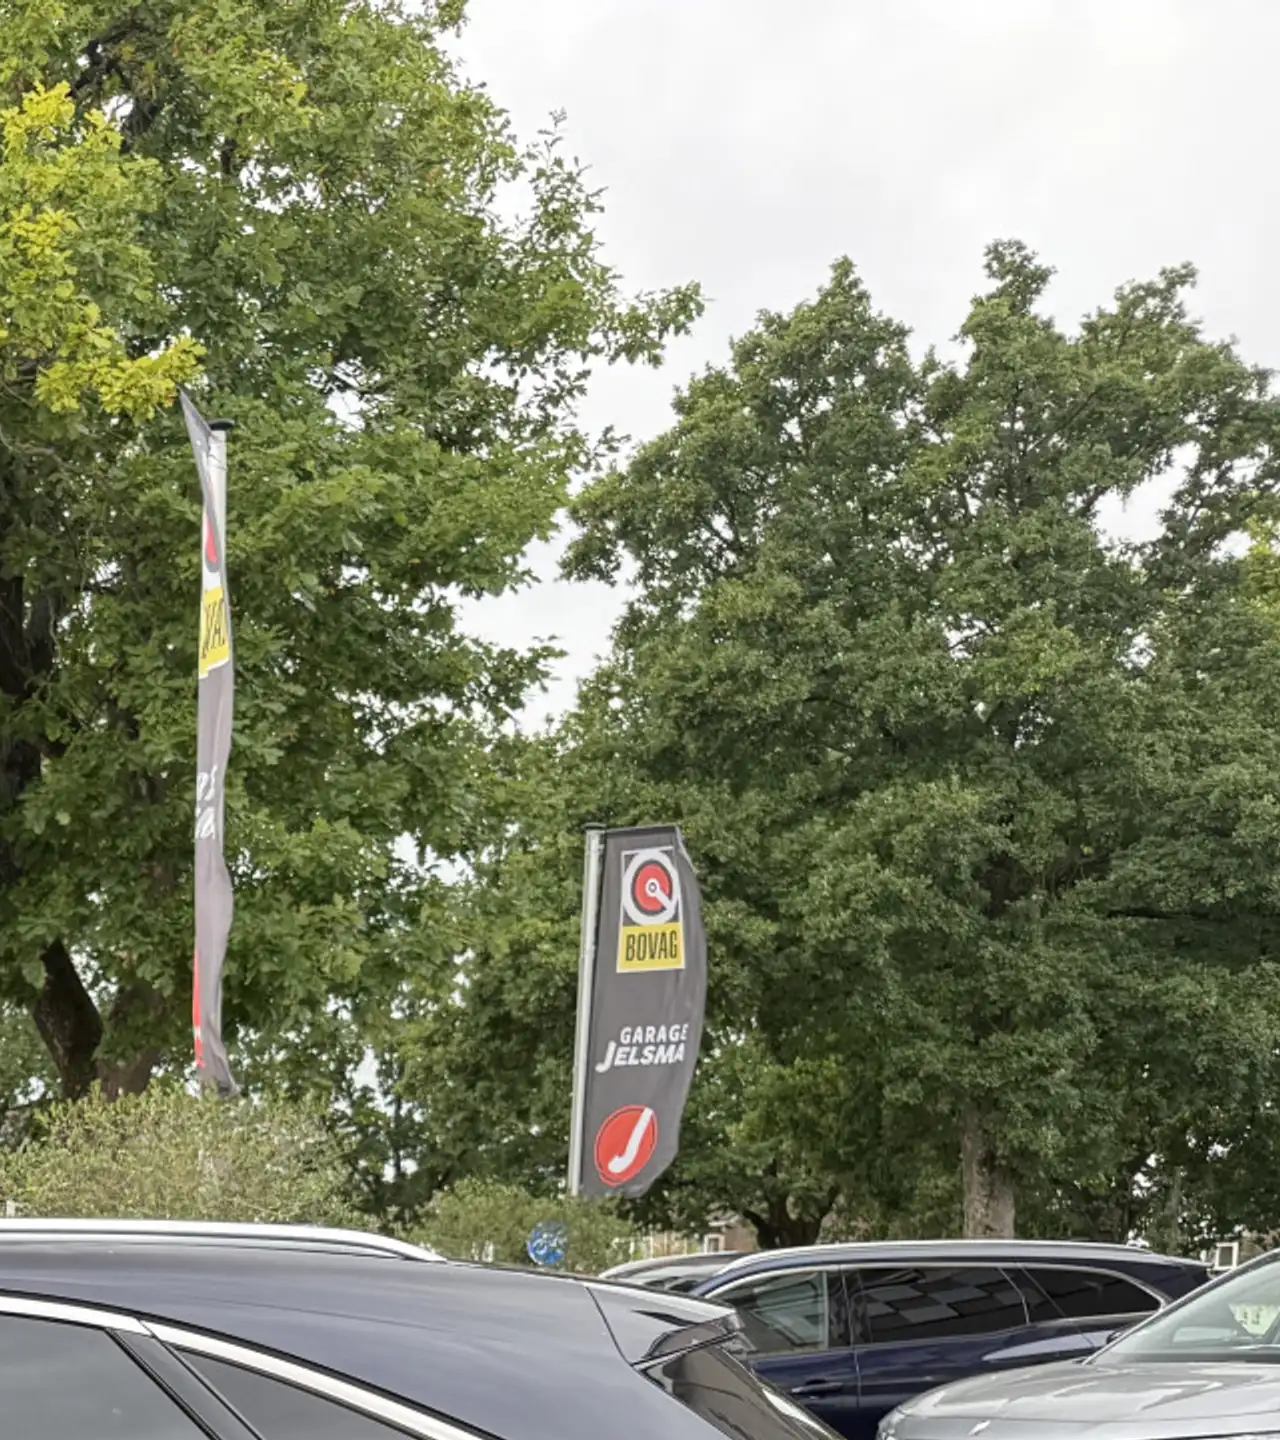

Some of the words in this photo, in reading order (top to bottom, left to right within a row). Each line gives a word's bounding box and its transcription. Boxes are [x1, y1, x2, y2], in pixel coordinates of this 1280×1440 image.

[626, 930, 678, 962] BOVAG
[620, 1023, 689, 1045] GARAGE
[595, 1040, 685, 1073] JELSMA
